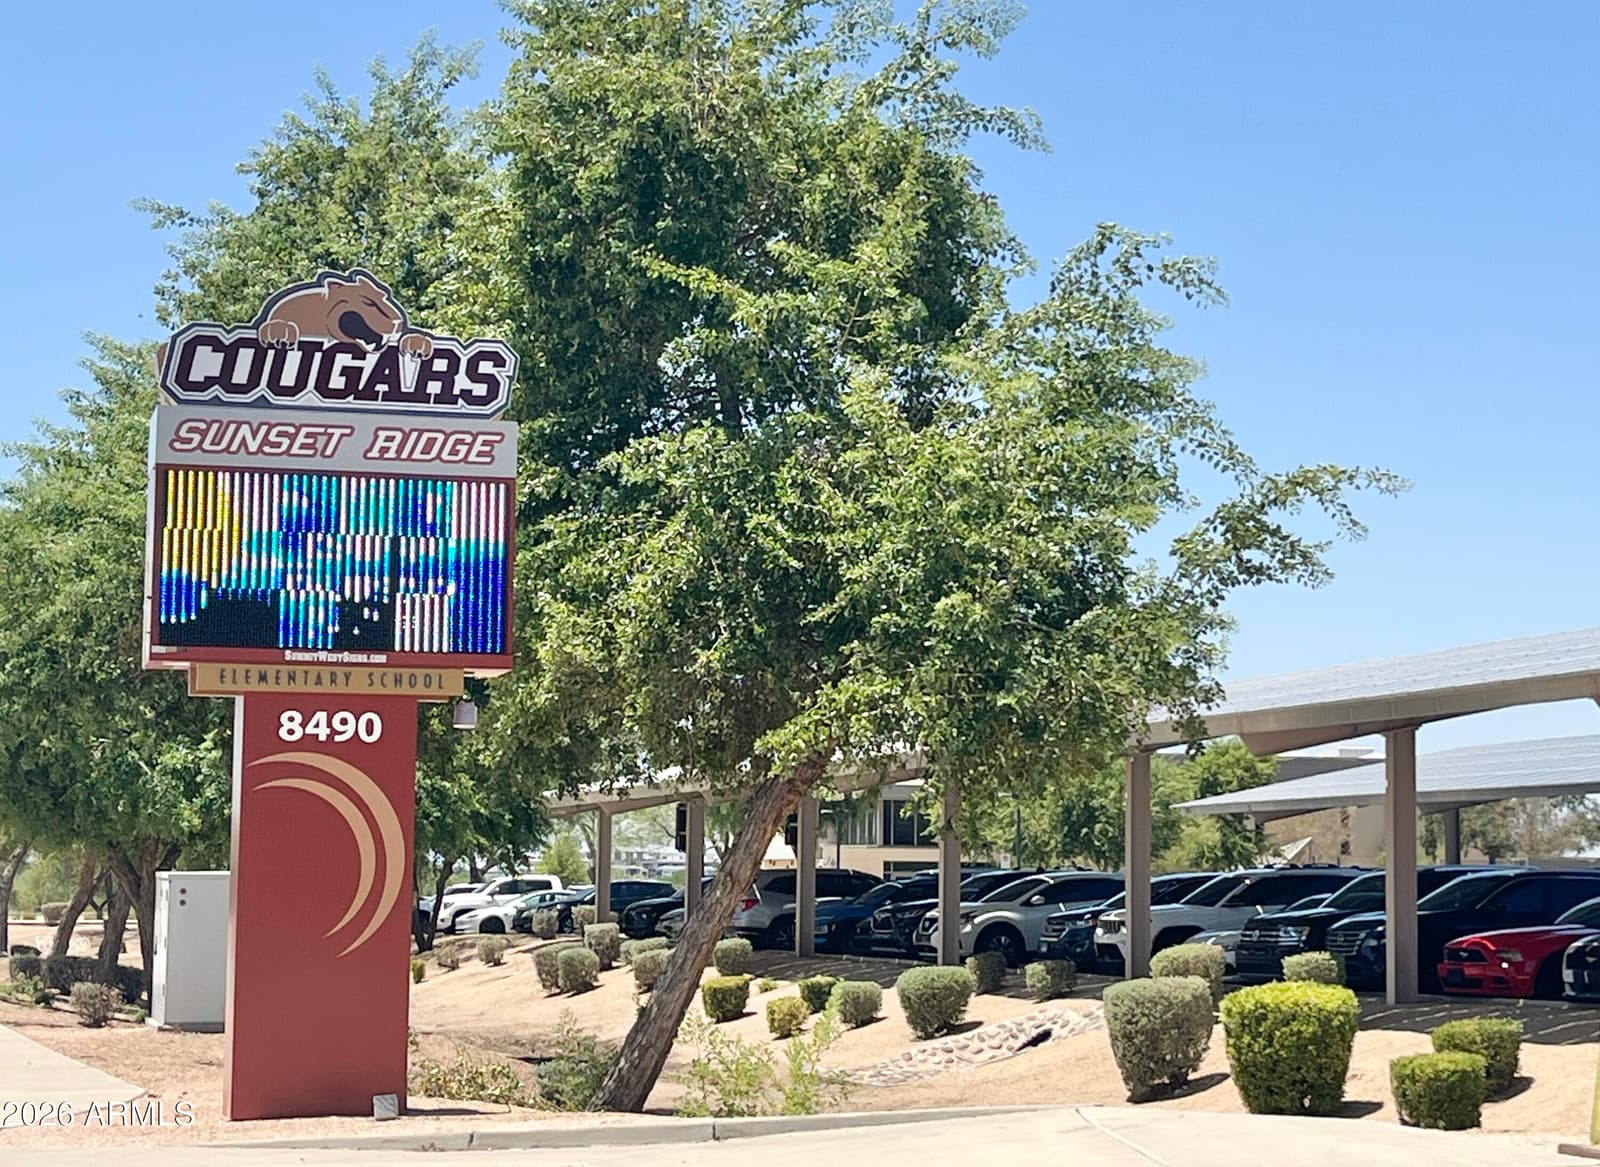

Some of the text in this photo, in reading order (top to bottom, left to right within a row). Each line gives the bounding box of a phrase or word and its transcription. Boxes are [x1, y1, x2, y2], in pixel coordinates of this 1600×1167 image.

[173, 333, 508, 406] COUGARS
[170, 419, 505, 464] SUNSET RIDGE
[219, 667, 446, 690] ELEMENTARY SCHOOL
[278, 710, 383, 744] 8490
